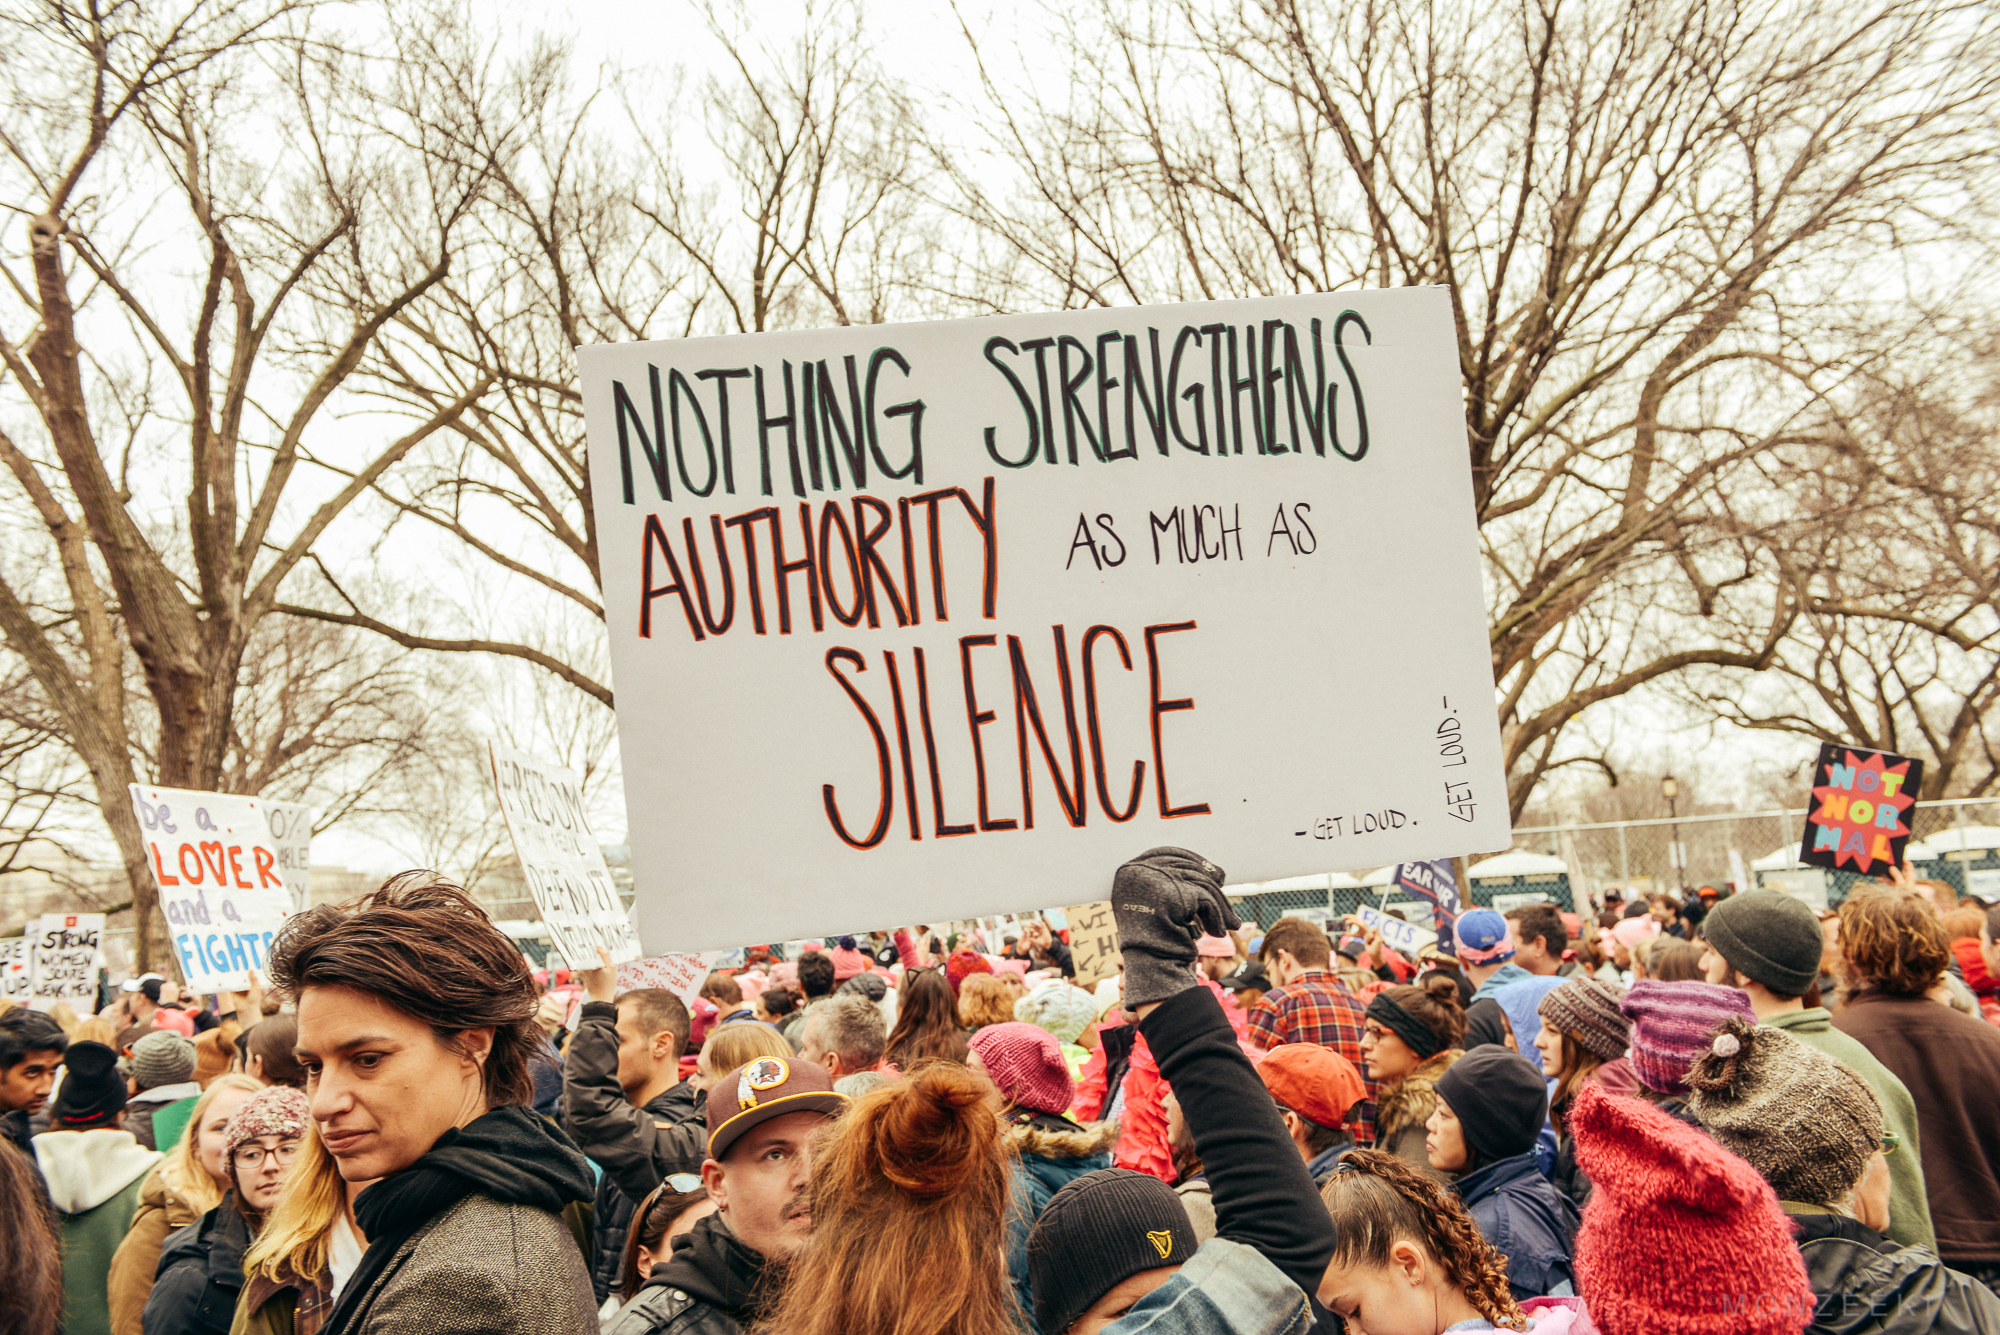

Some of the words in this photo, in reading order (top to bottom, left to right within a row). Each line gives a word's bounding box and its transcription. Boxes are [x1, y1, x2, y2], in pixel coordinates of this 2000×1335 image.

[612, 346, 927, 506] NOTHING
[983, 309, 1373, 470] STRENGTHENS
[638, 475, 998, 643] AUTHORITY
[1065, 512, 1127, 571] AS
[1150, 502, 1244, 566] MUCH
[1267, 502, 1317, 558] AS
[822, 619, 1213, 851] SILENCE
[1828, 761, 1906, 798] NOT
[134, 787, 178, 835] be
[195, 807, 218, 832] a
[1446, 780, 1478, 824] GET
[1821, 792, 1900, 831] NOR
[1813, 823, 1892, 862] MAL
[150, 840, 283, 890] LOVER
[167, 888, 212, 926] and
[221, 899, 242, 922] a
[1122, 903, 1156, 916] HEAD
[41, 929, 99, 950] STRONG
[41, 952, 92, 967] WOMEN
[72, 982, 93, 997] MEN
